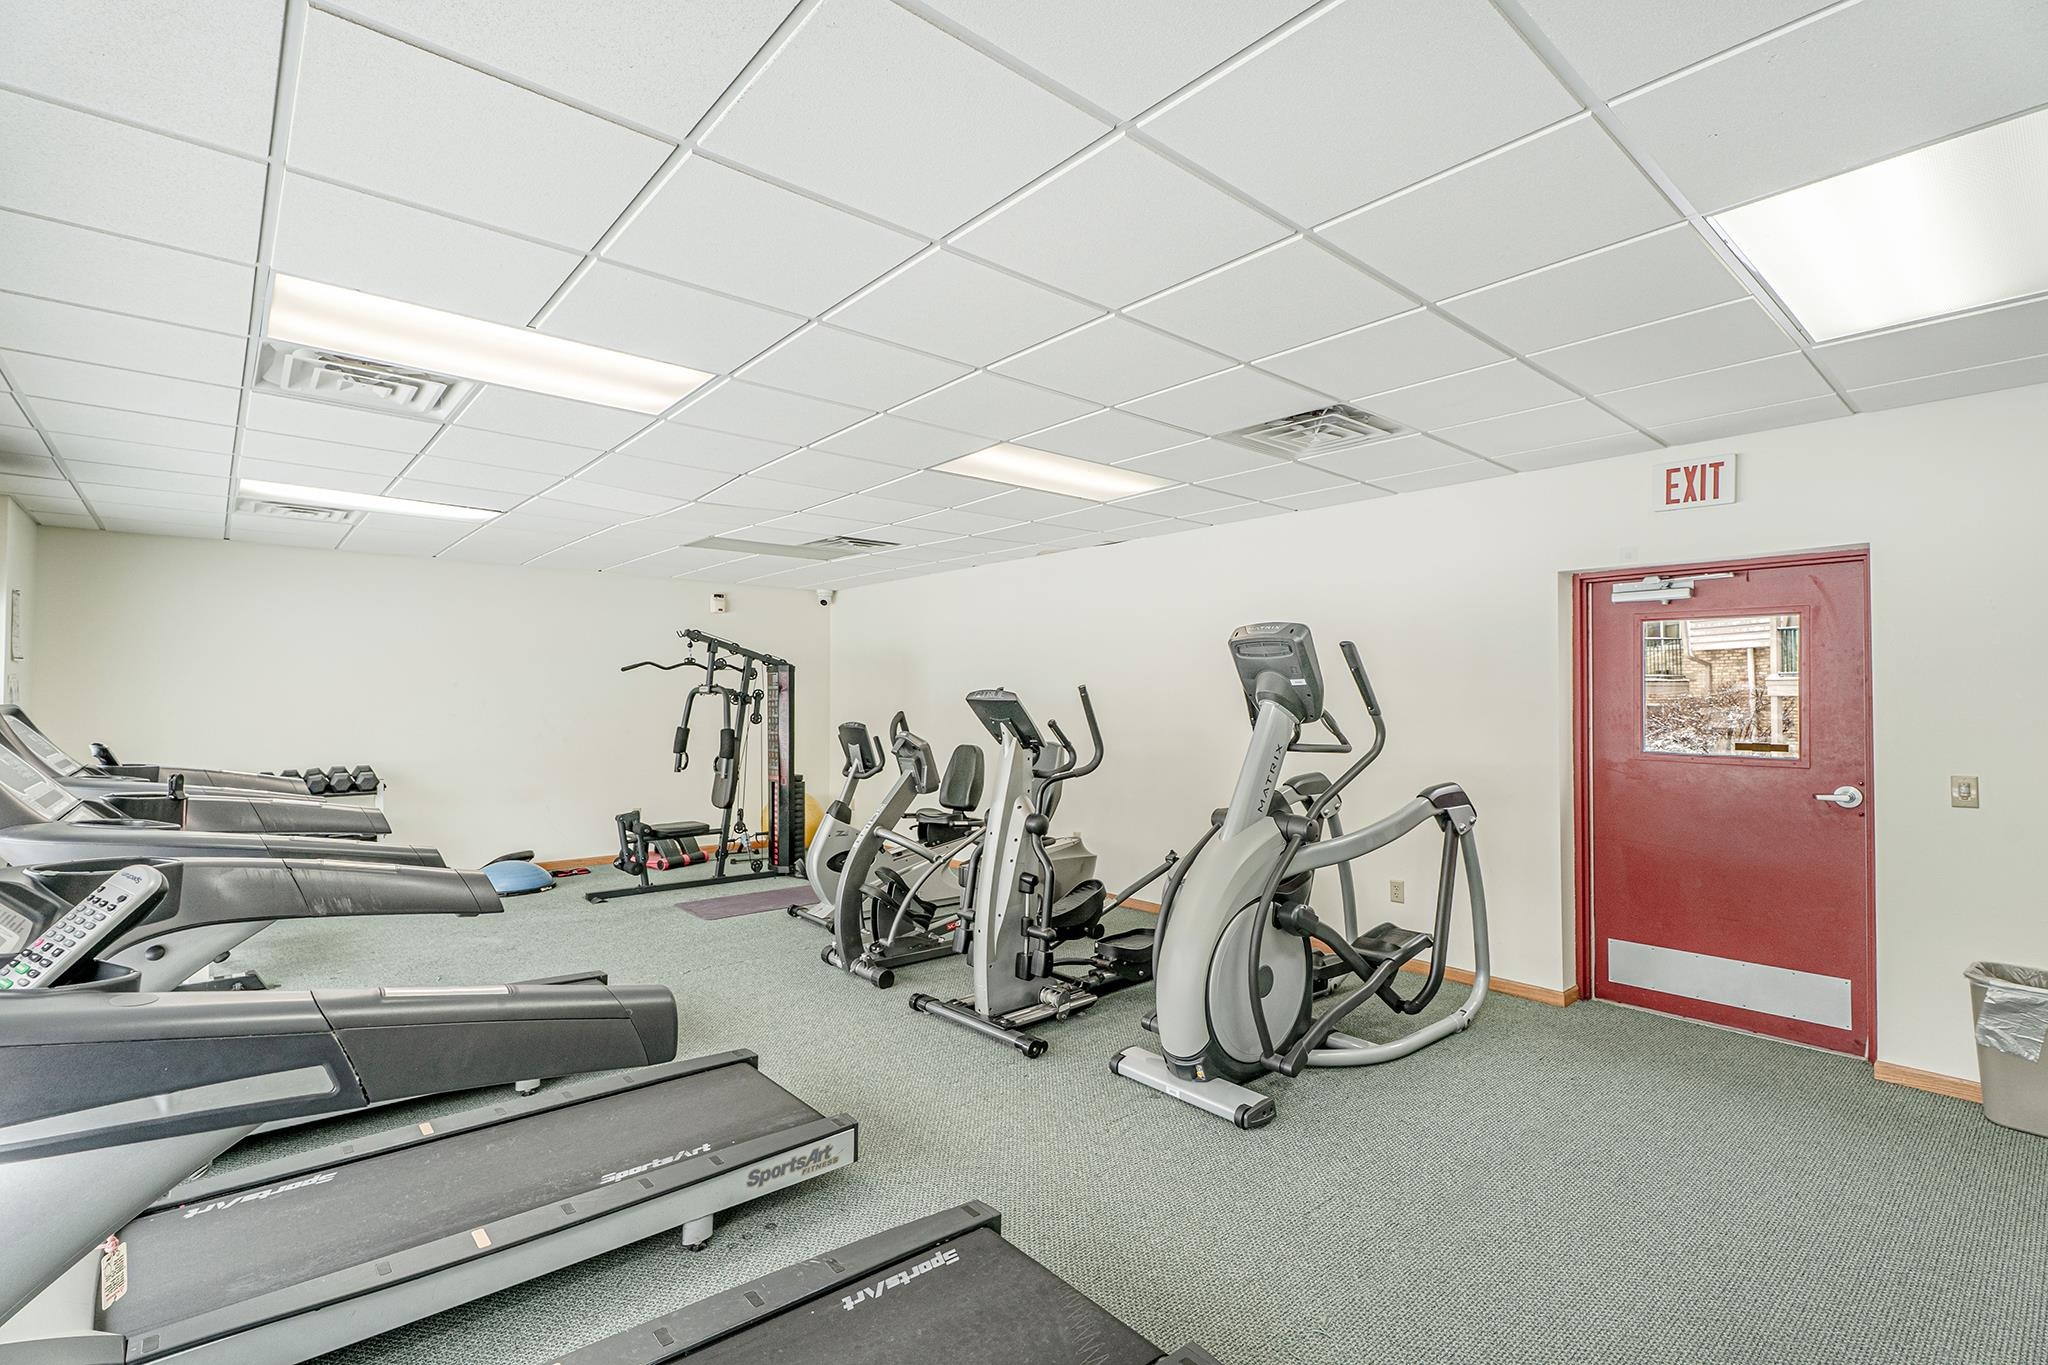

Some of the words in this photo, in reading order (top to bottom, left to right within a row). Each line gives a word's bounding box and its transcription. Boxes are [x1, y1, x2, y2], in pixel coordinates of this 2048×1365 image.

[1665, 461, 1725, 505] EXIT
[1257, 744, 1283, 813] MATRIX
[599, 1142, 712, 1185] SportsArt
[746, 1143, 833, 1189] SportsArt
[801, 1155, 839, 1176] FITNESS
[183, 1171, 338, 1219] SportsArt
[841, 1248, 960, 1312] SportsArt
